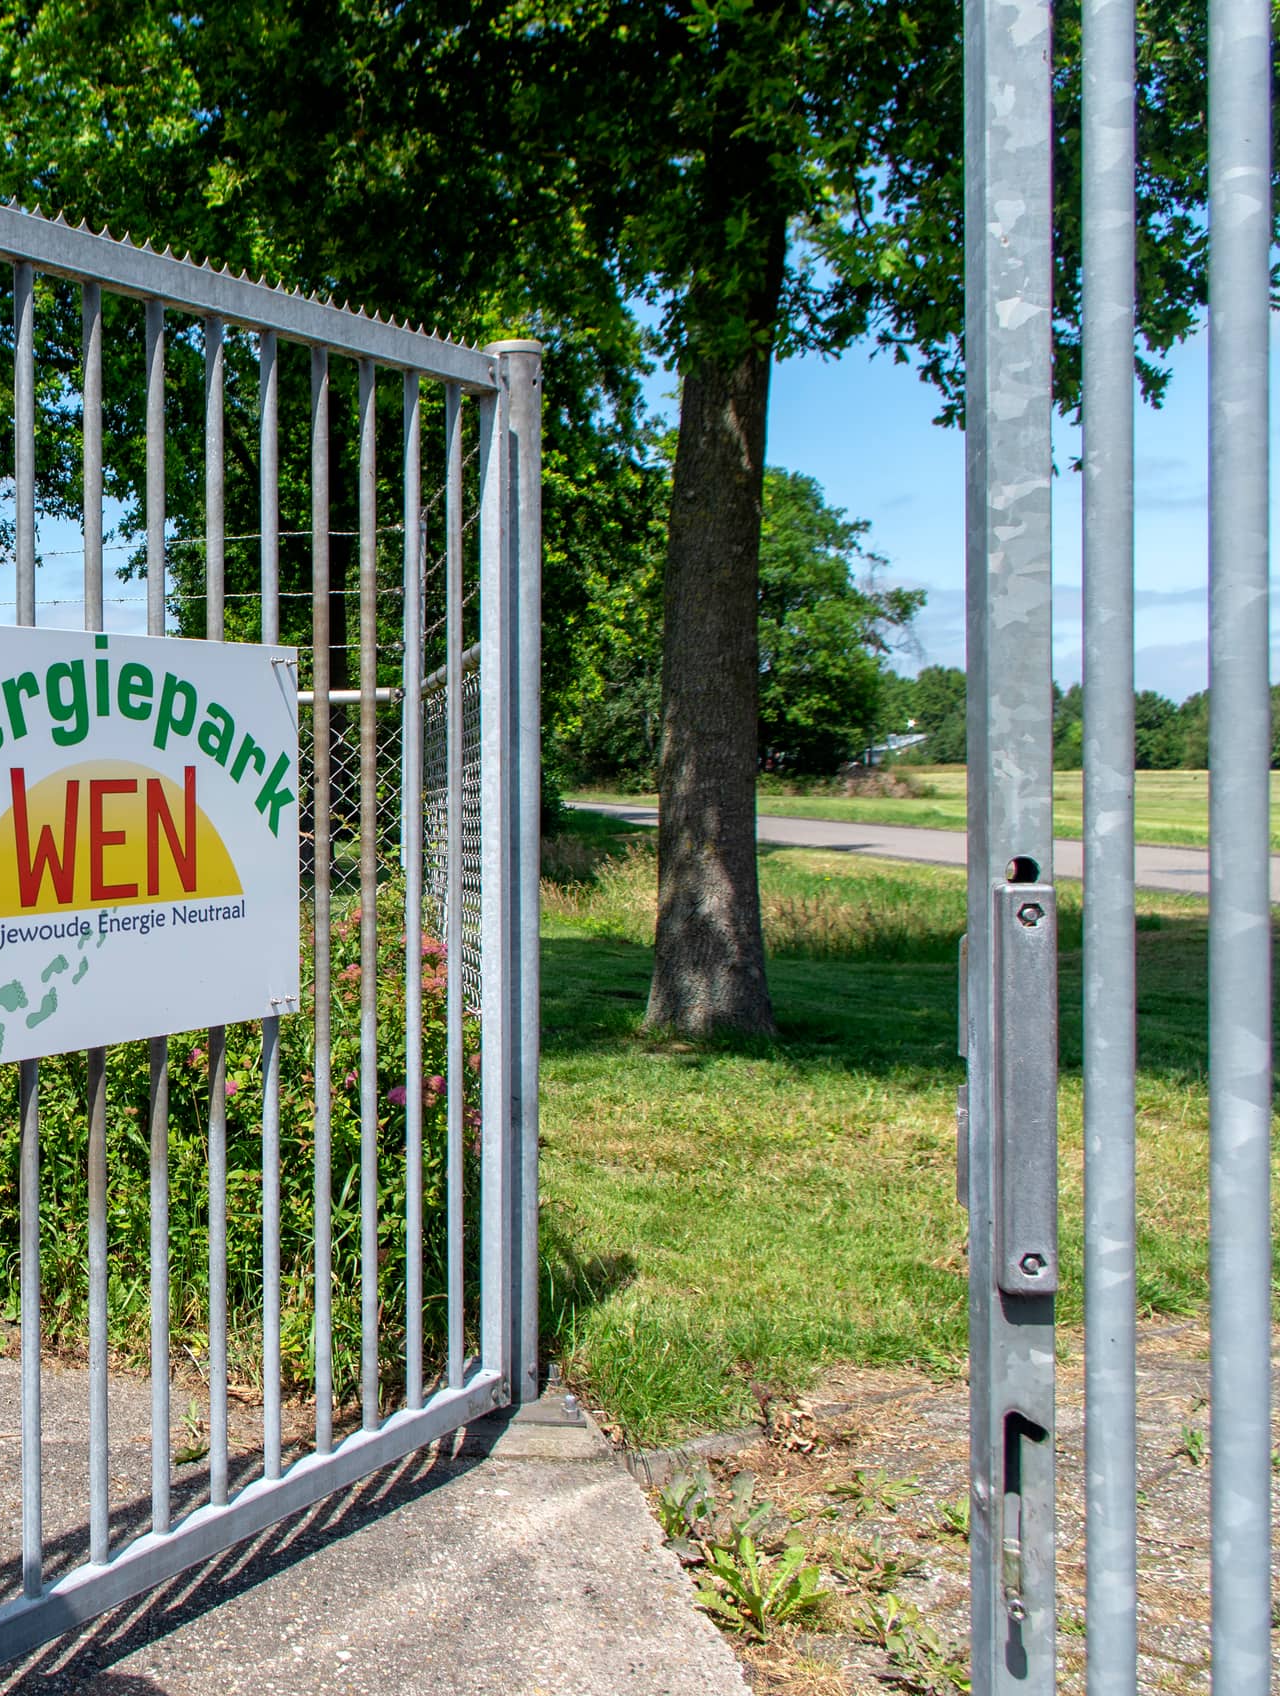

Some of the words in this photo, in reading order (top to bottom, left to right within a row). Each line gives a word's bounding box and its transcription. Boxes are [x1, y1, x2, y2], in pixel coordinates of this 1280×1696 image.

[10, 766, 197, 908] WEN
[98, 909, 166, 935] Energie
[172, 899, 245, 926] Neutraal
